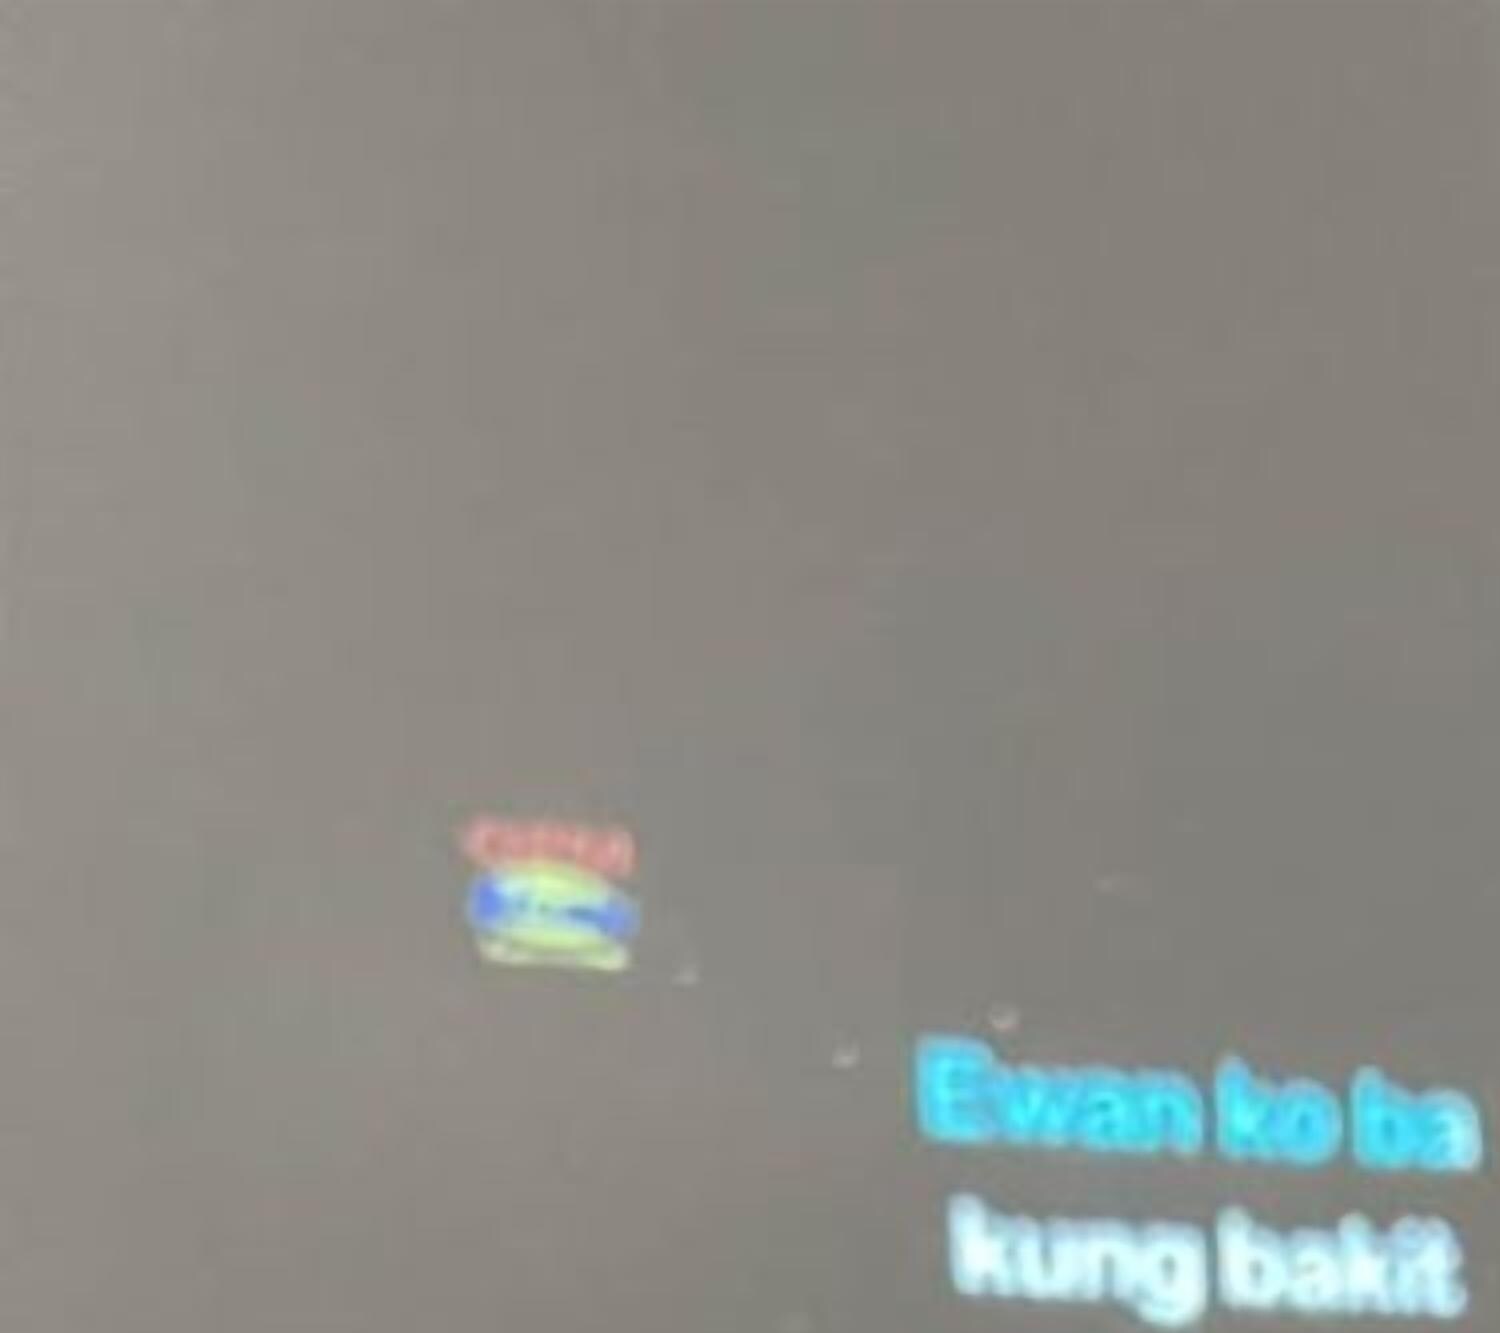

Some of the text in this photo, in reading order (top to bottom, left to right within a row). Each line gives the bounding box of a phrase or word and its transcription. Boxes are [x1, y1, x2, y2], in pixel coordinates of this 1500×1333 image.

[915, 1033, 1482, 1170] Ewan ko ba
[947, 1193, 1466, 1328] kung bakit
